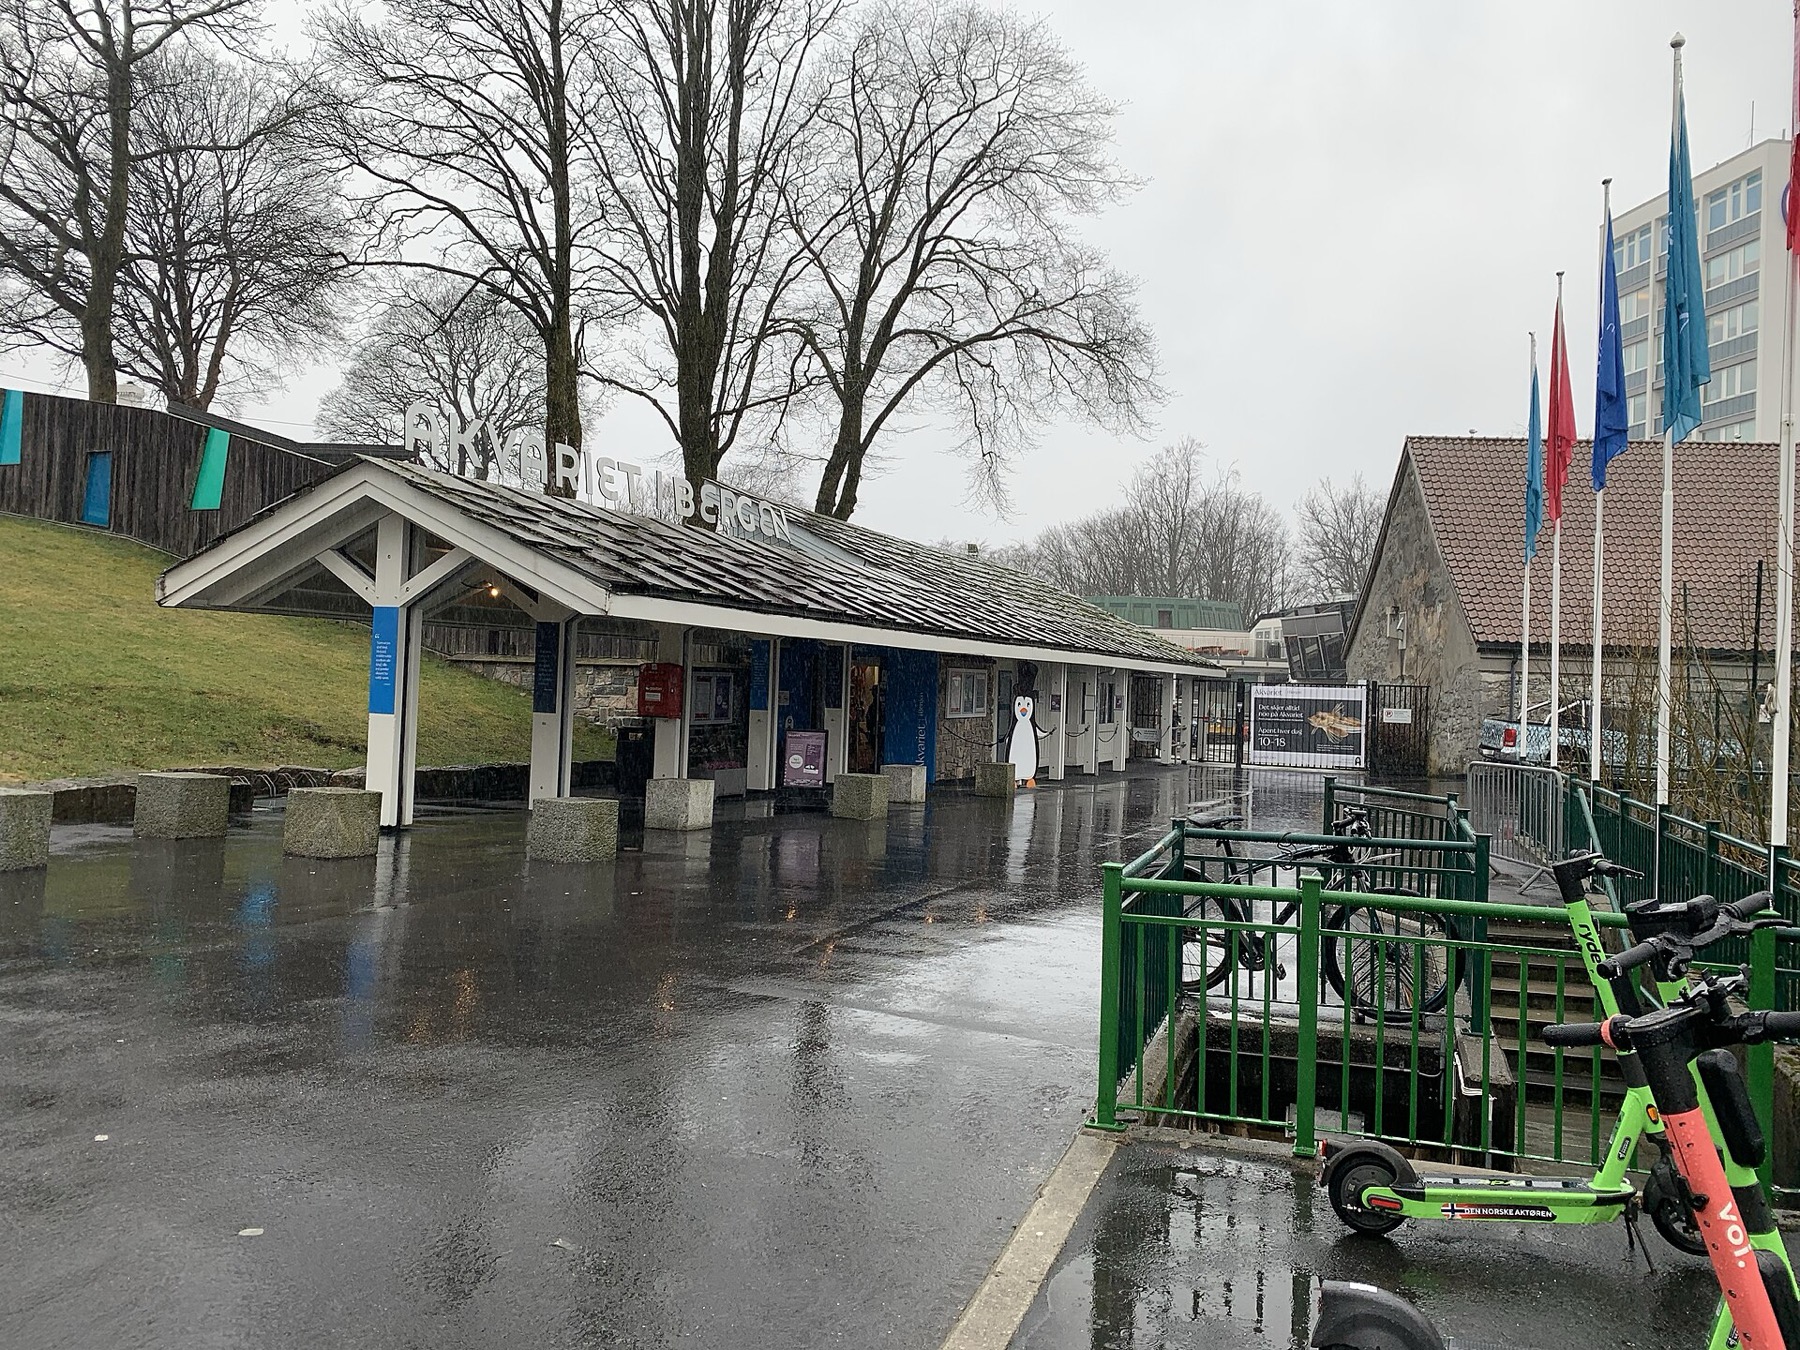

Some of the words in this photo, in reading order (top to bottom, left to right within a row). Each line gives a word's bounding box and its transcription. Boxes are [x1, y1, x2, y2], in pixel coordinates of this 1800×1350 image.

[404, 402, 642, 505] AKVARIET
[655, 470, 663, 511] I
[671, 475, 792, 544] BERGEN
[1254, 687, 1282, 697] Akvariet
[915, 724, 926, 766] kvariet
[1257, 736, 1287, 748] 10-18
[1578, 922, 1602, 964] ryde
[1464, 1207, 1481, 1215] DEN
[1481, 1208, 1514, 1216] NORSKE
[1514, 1209, 1553, 1218] AKTØREN
